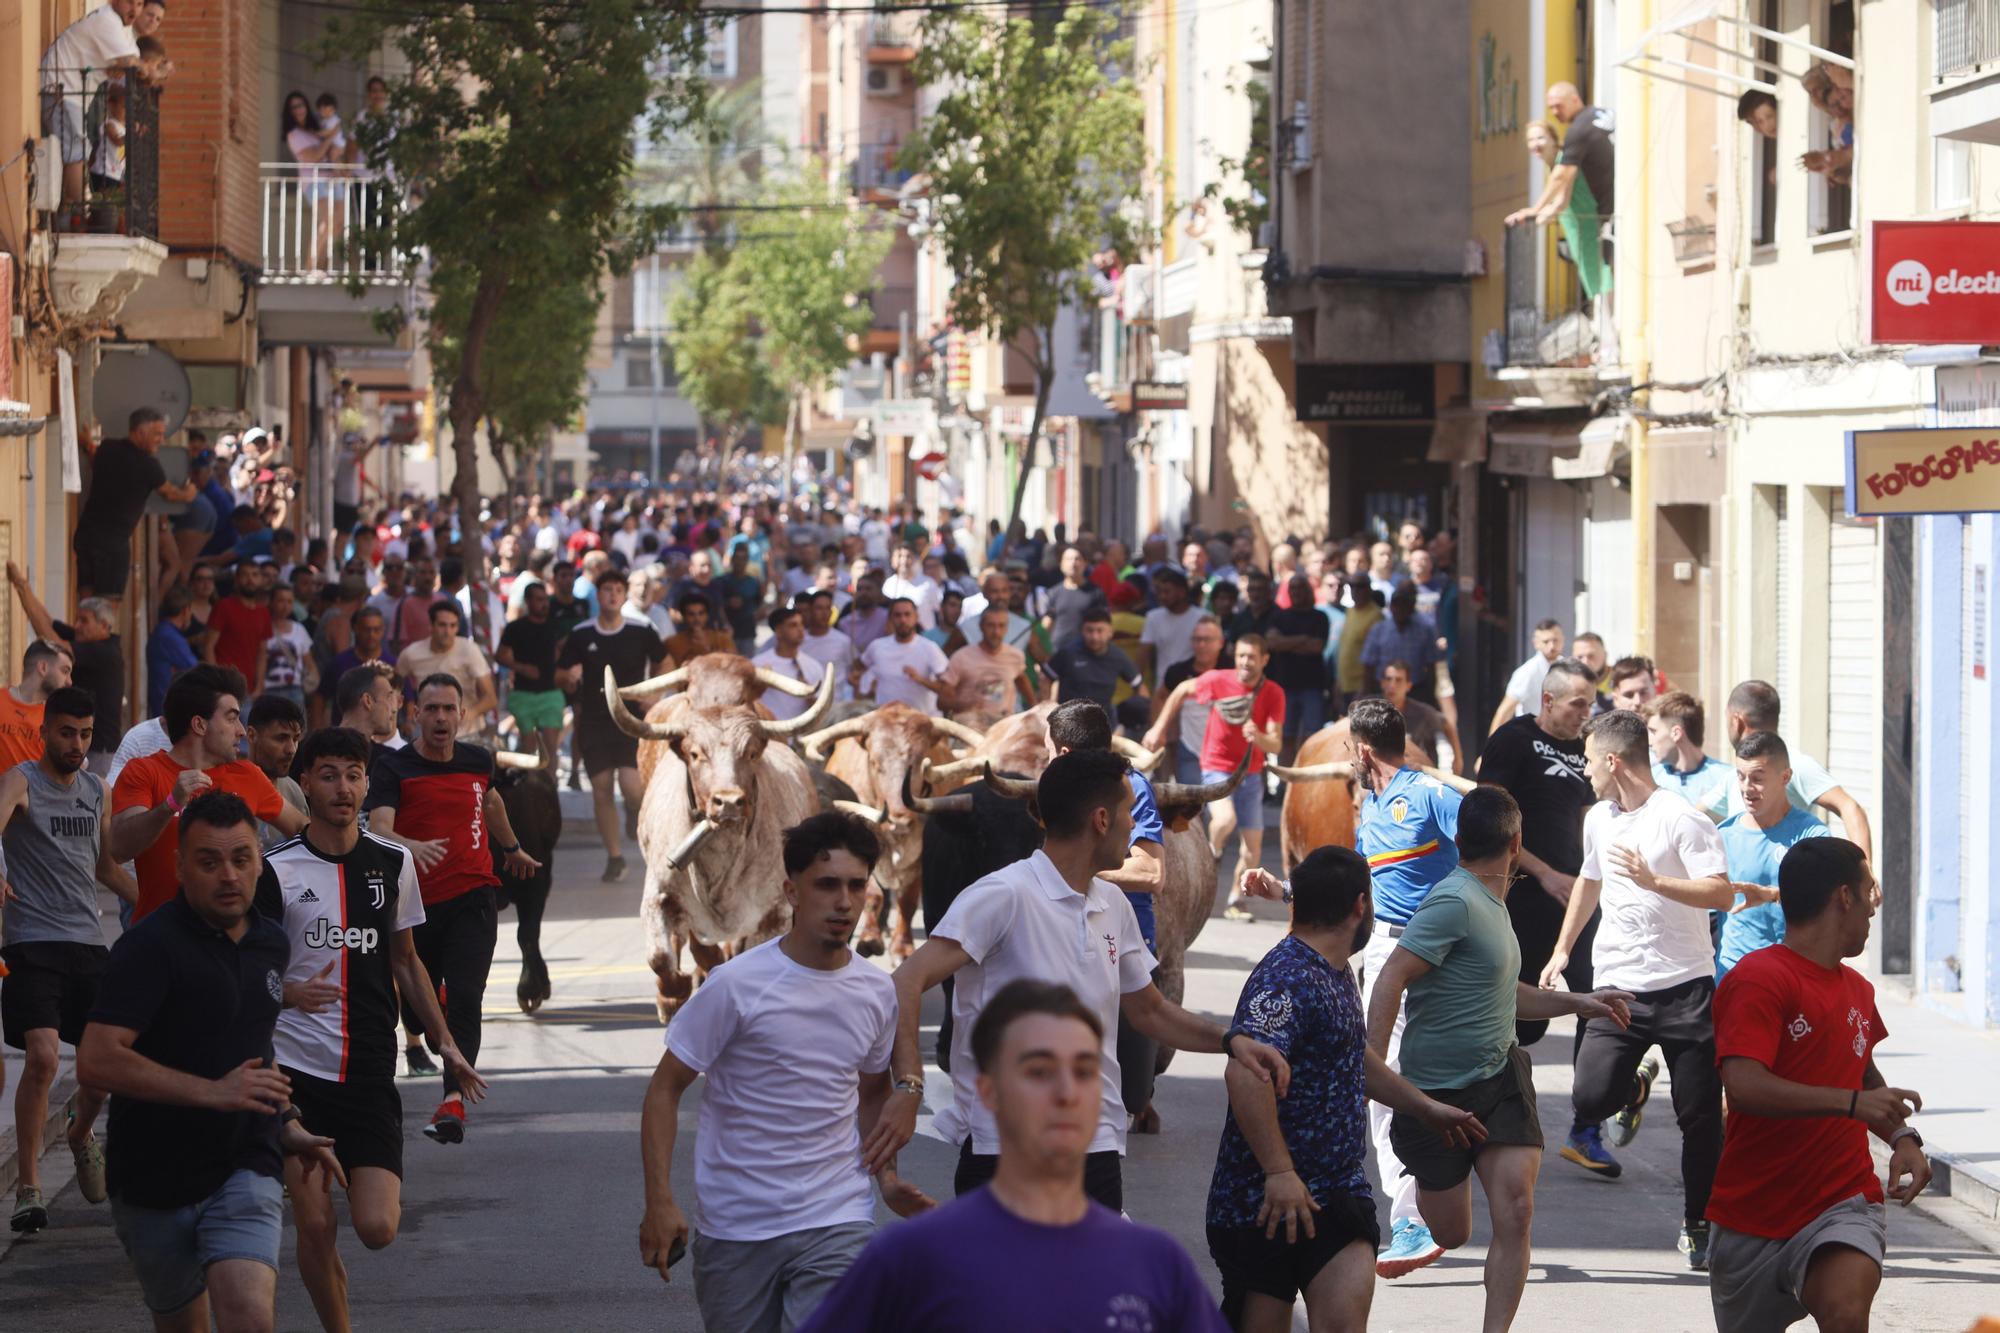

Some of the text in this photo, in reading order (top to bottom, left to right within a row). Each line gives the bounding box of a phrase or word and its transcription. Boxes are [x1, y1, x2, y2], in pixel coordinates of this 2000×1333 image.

[1895, 272, 1923, 292] mi
[1865, 439, 2000, 500] FOTOCOPIAS
[49, 816, 95, 837] PUMA
[298, 895, 320, 904] adidas
[305, 917, 379, 955] Jeep
[1263, 998, 1282, 1012] 40
